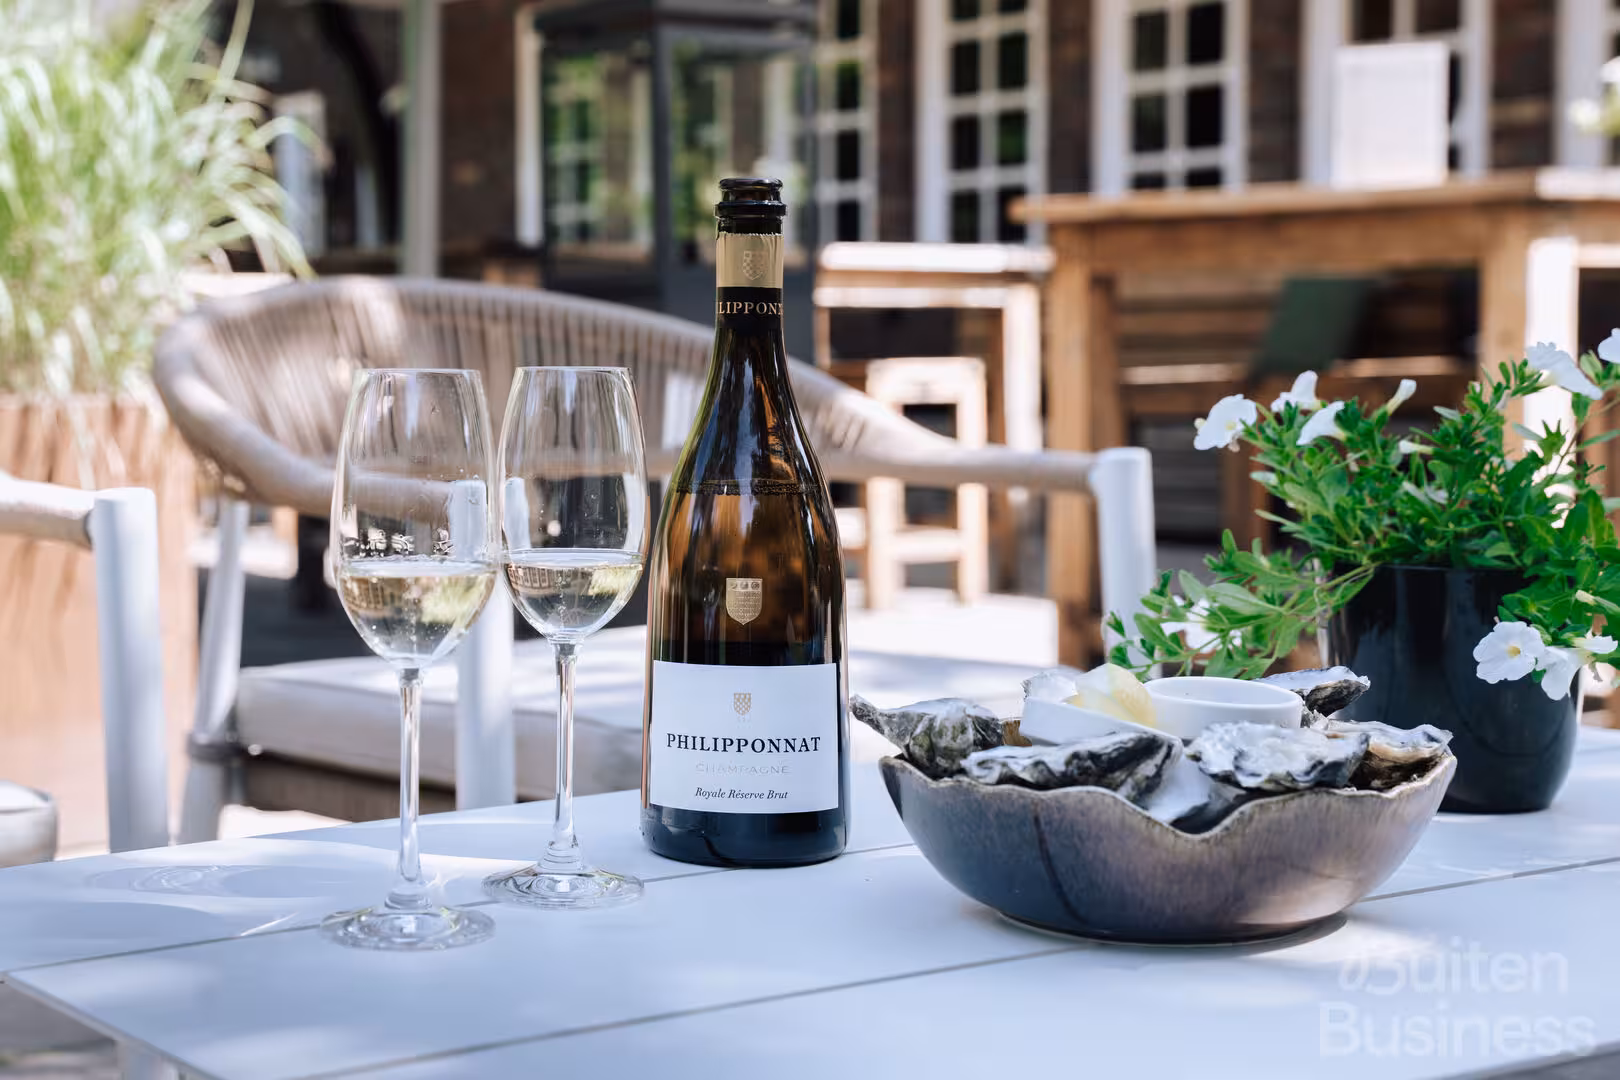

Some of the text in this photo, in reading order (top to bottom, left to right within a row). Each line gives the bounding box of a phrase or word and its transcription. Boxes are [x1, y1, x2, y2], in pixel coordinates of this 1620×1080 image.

[666, 732, 821, 754] PHILIPPONNAT
[695, 762, 792, 775] CHAMPAGNE
[695, 787, 789, 799] Royale Réserve Brut
